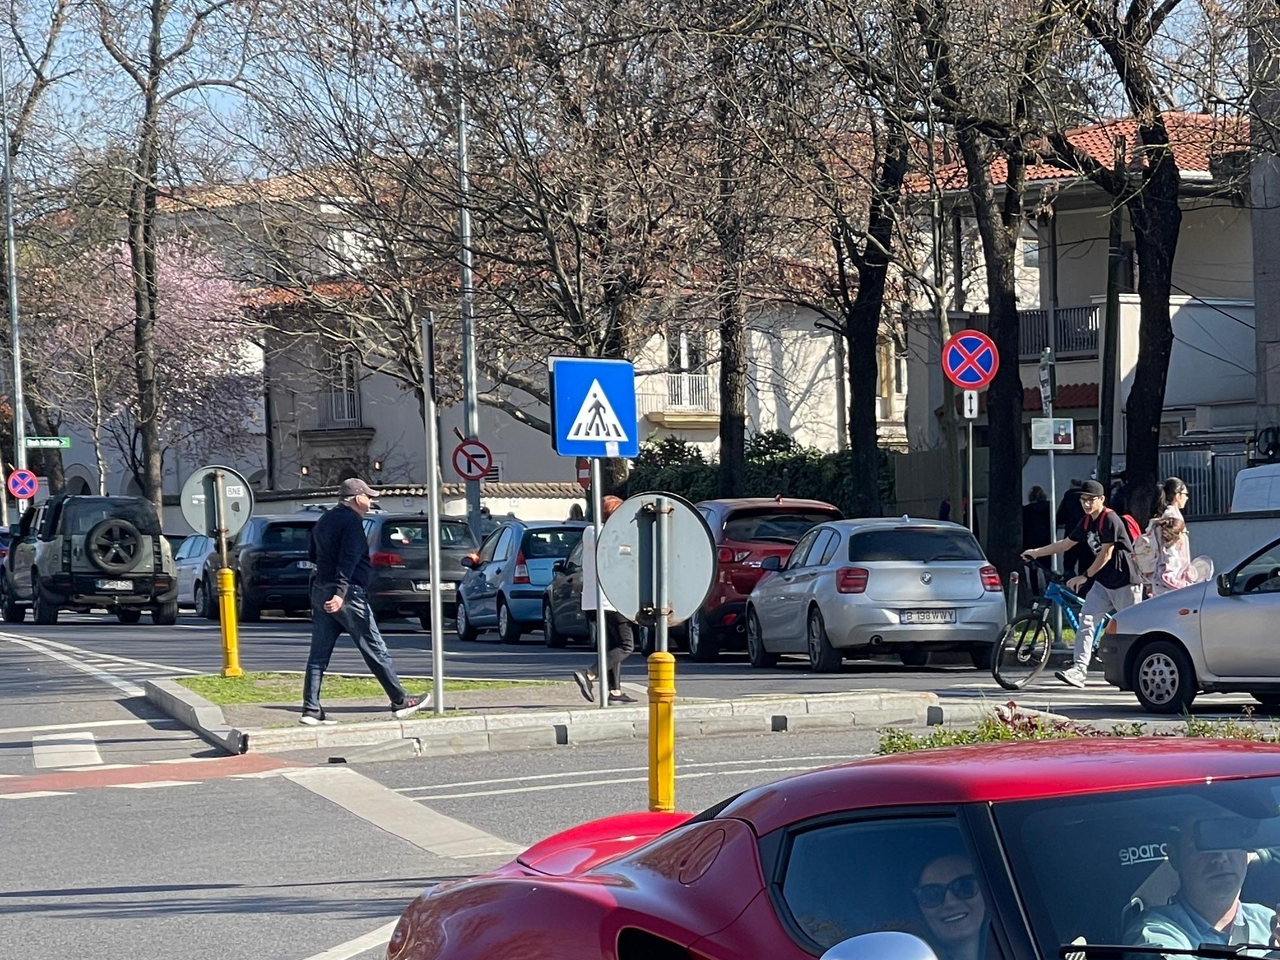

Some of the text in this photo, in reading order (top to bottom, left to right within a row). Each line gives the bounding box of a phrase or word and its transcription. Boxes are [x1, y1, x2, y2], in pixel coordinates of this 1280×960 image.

[227, 487, 241, 496] BNE
[906, 611, 913, 621] B
[917, 611, 931, 620] 198
